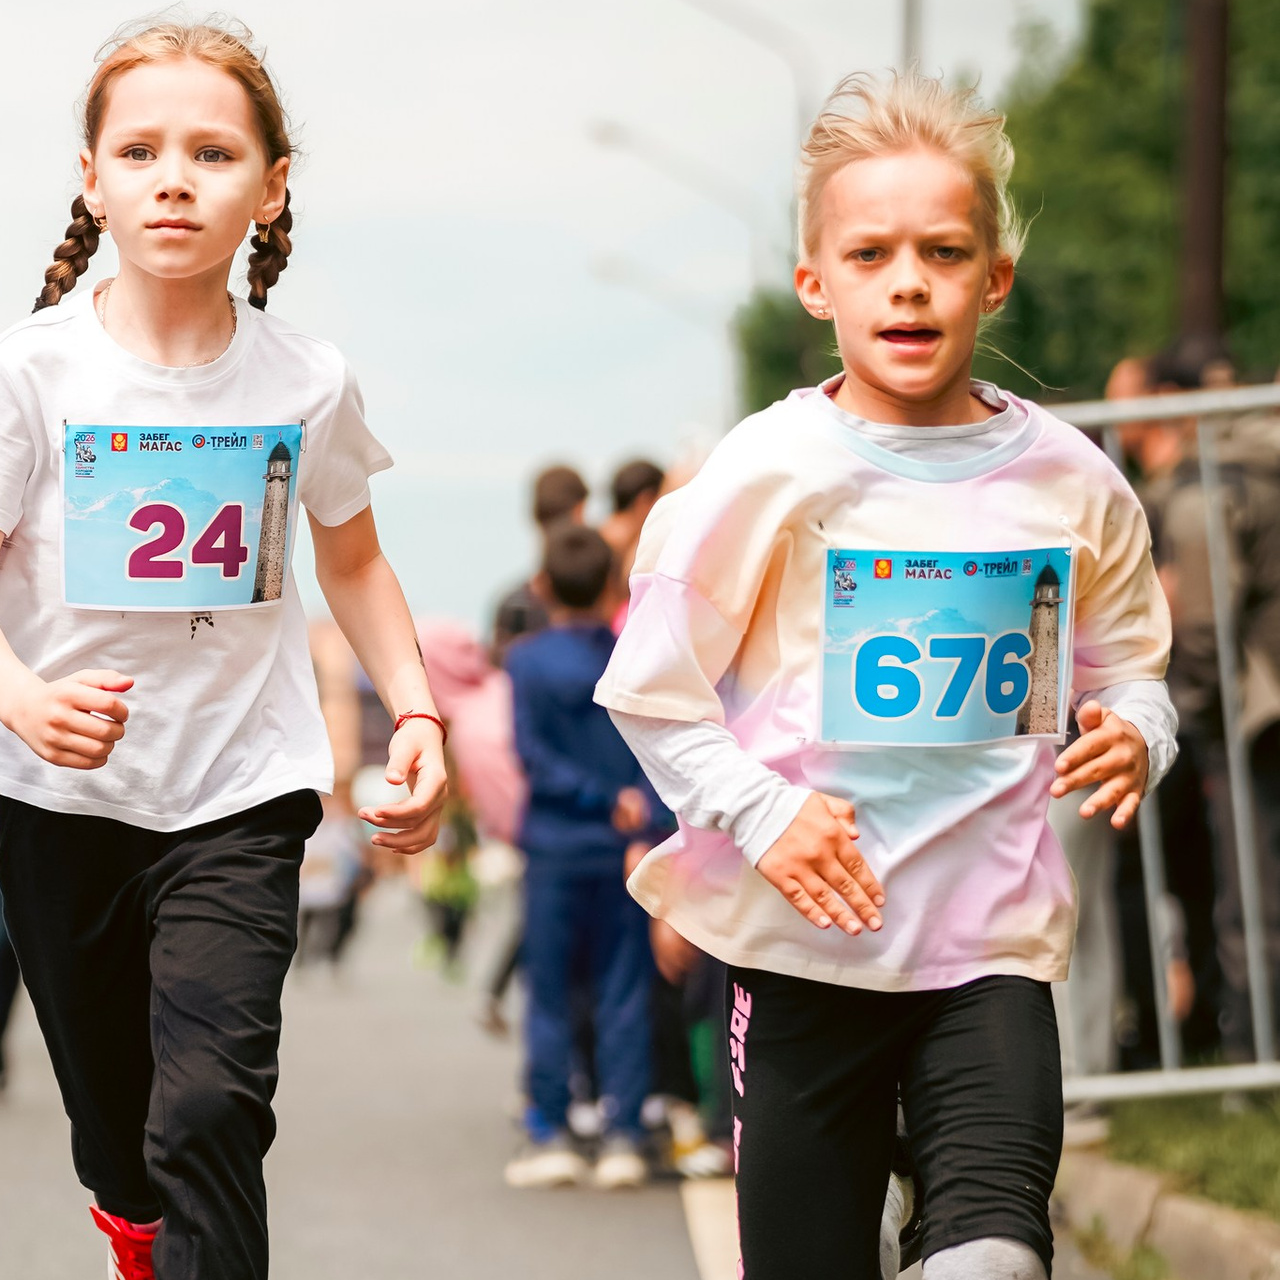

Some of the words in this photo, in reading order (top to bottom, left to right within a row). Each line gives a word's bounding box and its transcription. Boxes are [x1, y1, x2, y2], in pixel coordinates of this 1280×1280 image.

[139, 433, 170, 441] ЗАБЕГ
[139, 441, 183, 452] МАГАС
[128, 504, 248, 578] 24
[905, 559, 939, 568] ЗАБЕГ
[904, 568, 952, 580] МАГАС
[855, 632, 1031, 718] 676
